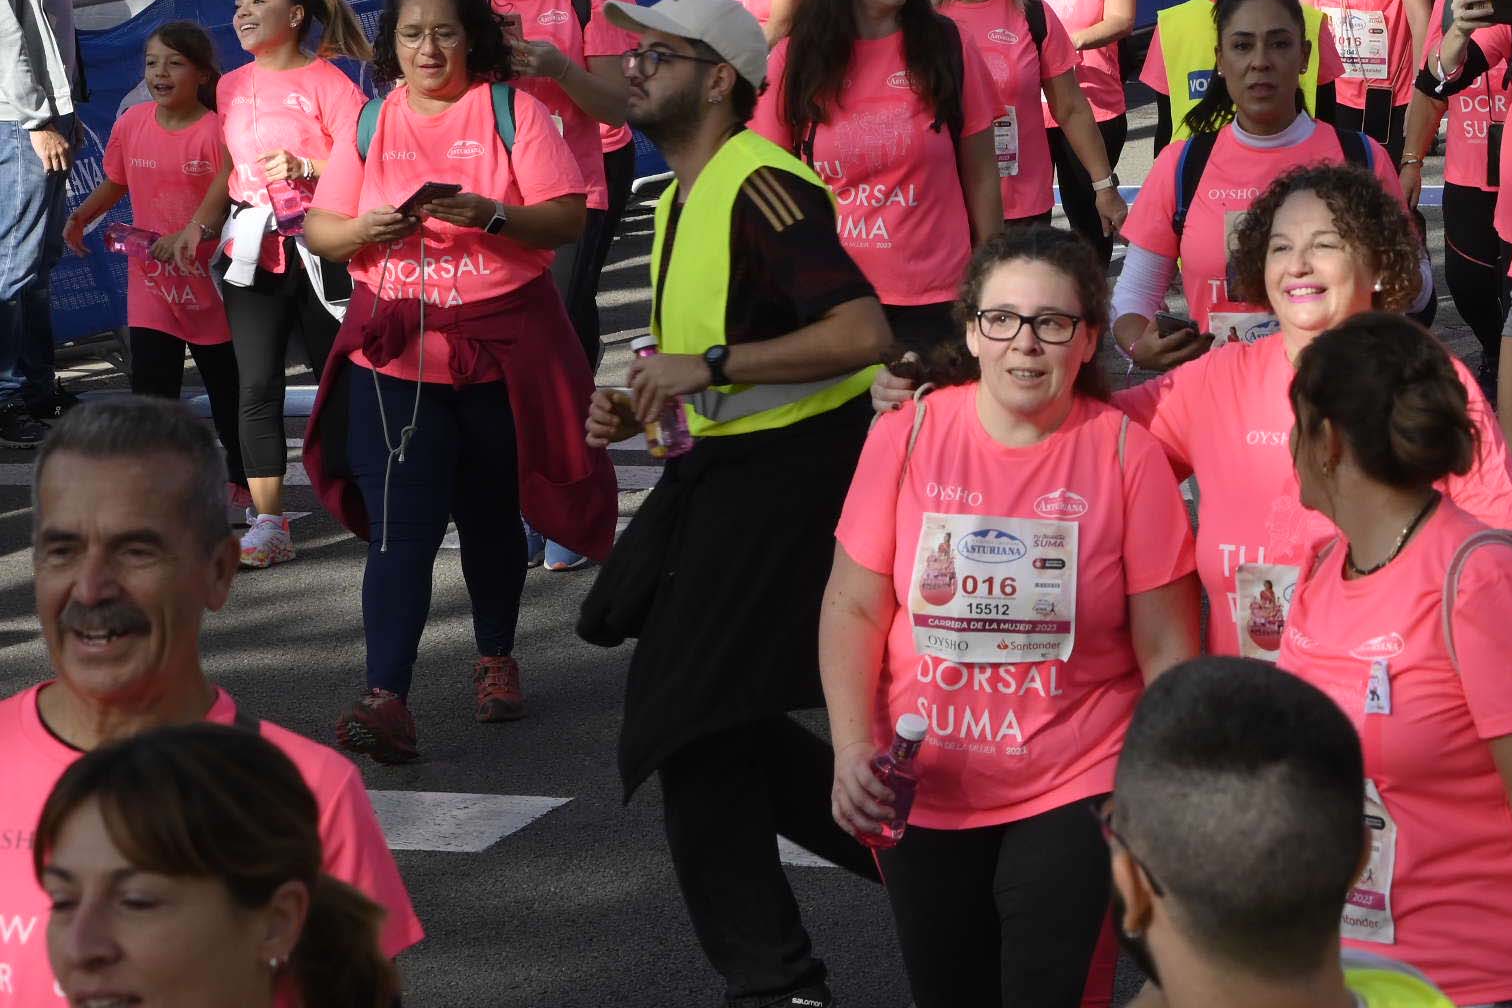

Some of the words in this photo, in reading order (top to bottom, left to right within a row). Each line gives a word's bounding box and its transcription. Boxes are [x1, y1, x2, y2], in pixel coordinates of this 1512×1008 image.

[830, 183, 919, 208] ORSAL
[1208, 187, 1260, 201] OYSHO
[384, 253, 491, 283] DORSAL
[926, 482, 983, 507] OYSHO
[961, 541, 1022, 556] ASTURIANA
[1033, 539, 1065, 548] SUMA
[962, 575, 1017, 597] 016
[966, 602, 1010, 617] 15512
[928, 618, 969, 630] CARRERA
[970, 620, 984, 629] DE
[985, 621, 998, 630] LA
[999, 621, 1032, 631] MUJER
[1035, 623, 1058, 632] 2023
[928, 634, 969, 652] OYSHO
[1010, 640, 1061, 651] Santander
[917, 655, 1064, 697] DORSAL
[917, 696, 1024, 743] SUMA
[1352, 893, 1373, 905] 2023
